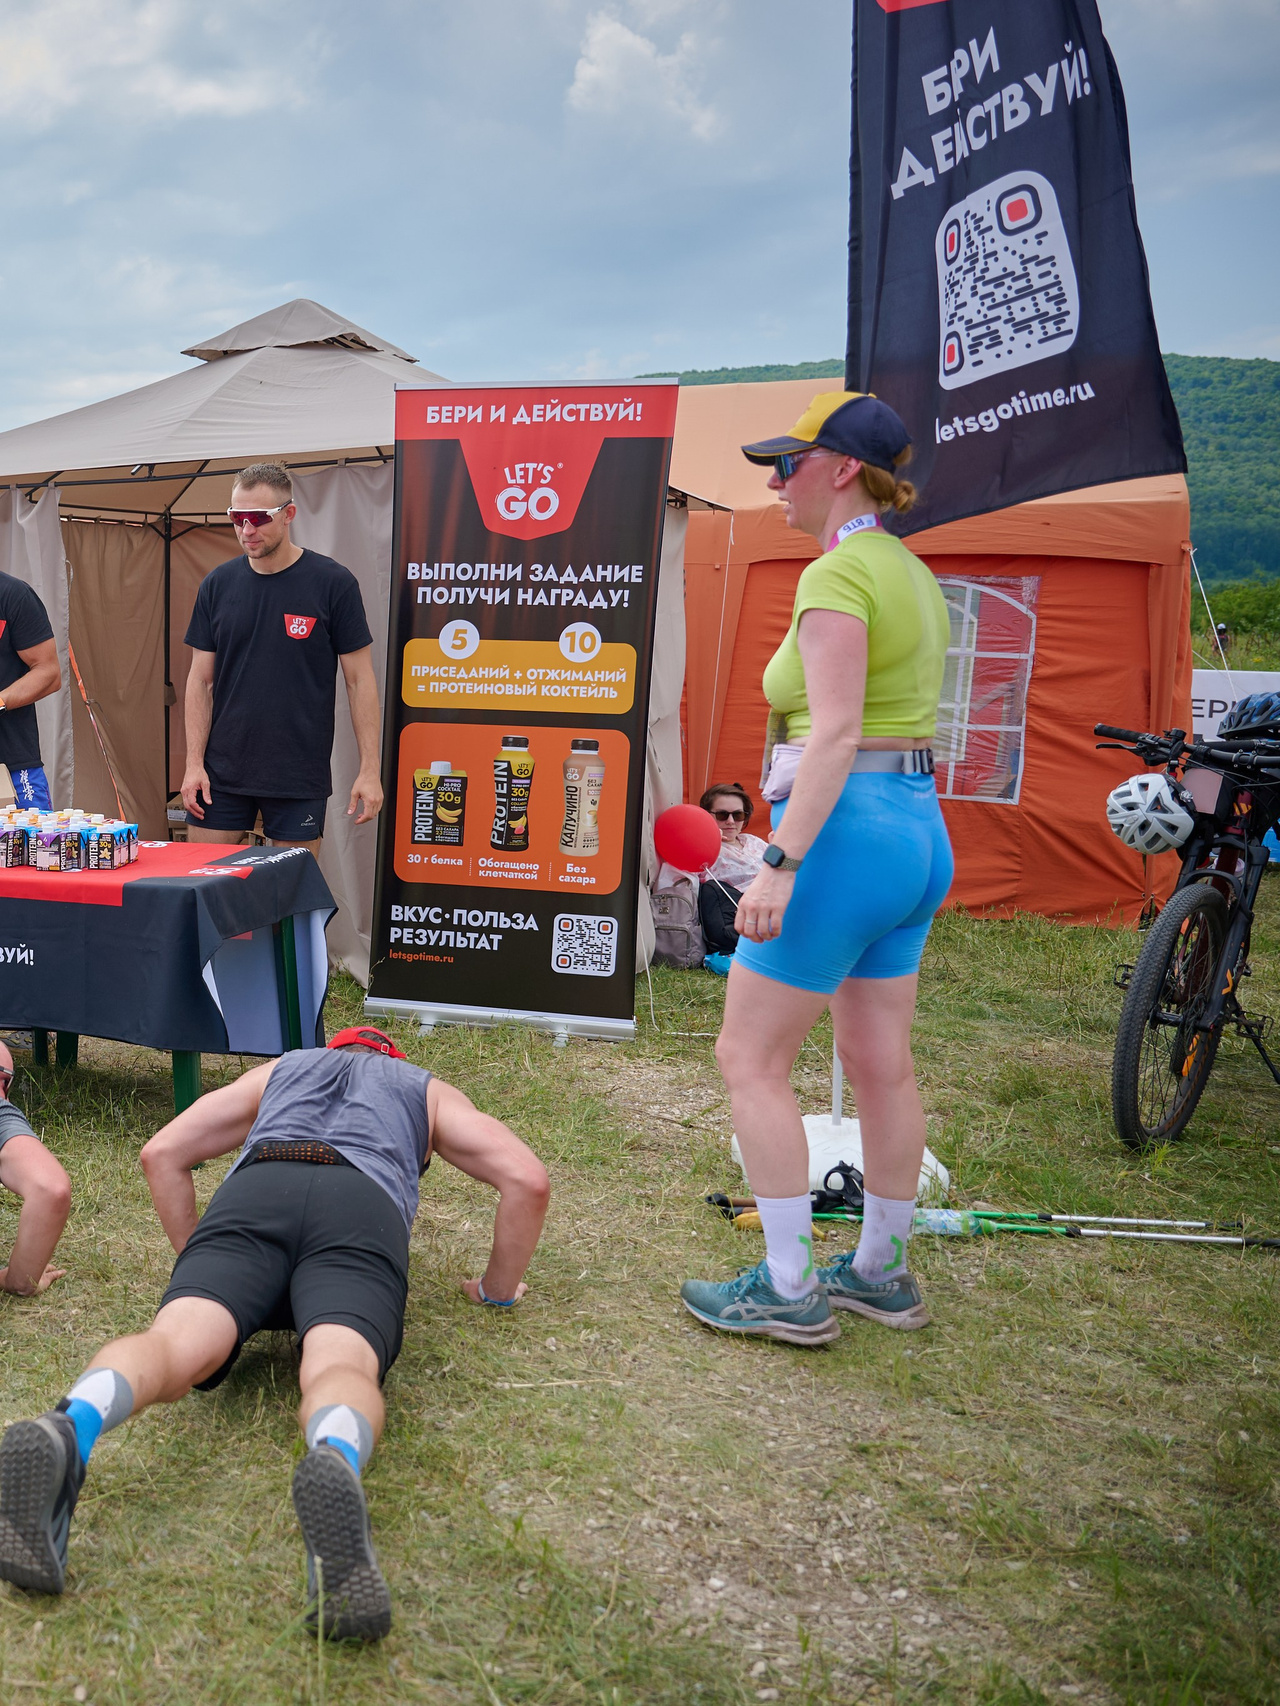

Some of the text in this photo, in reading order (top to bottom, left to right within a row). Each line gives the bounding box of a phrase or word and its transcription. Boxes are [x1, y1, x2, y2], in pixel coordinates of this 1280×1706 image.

[921, 25, 1000, 116] БРИ
[426, 398, 643, 425] БЕРИ И ДЕЙСТВУЙ!
[935, 381, 1095, 443] letsgotime.ru
[504, 462, 555, 485] LET'S
[496, 485, 560, 521] GO
[407, 562, 644, 585] ВЫПОЛНИ ЗАДАНИЕ
[417, 587, 630, 610] ПОЛУЧИ НАГРАДУ!
[289, 624, 308, 635] GO
[450, 628, 469, 651] 5
[565, 631, 598, 654] 10
[411, 664, 627, 683] ПРИСЕДАНИЙ ОТЖИМАНИЙ
[429, 680, 618, 699] ПРОТЕИНОВЫЙ КОКТЕЙЛЬ
[437, 791, 461, 804] 30g
[490, 761, 508, 845] PROTEIN
[414, 790, 434, 842] PROTEIN
[561, 785, 578, 848] КАПУЧИНО
[407, 854, 421, 864] 30
[431, 854, 463, 866] белка
[478, 857, 539, 872] Обогащено
[566, 863, 587, 874] Без
[478, 868, 538, 881] клетчаткой
[558, 875, 596, 885] сахара
[390, 904, 539, 931] ВКУС ПОЛЬЗА
[389, 926, 503, 951] РЕЗУЛЬТАТ
[389, 948, 454, 965] letsgotime.ru
